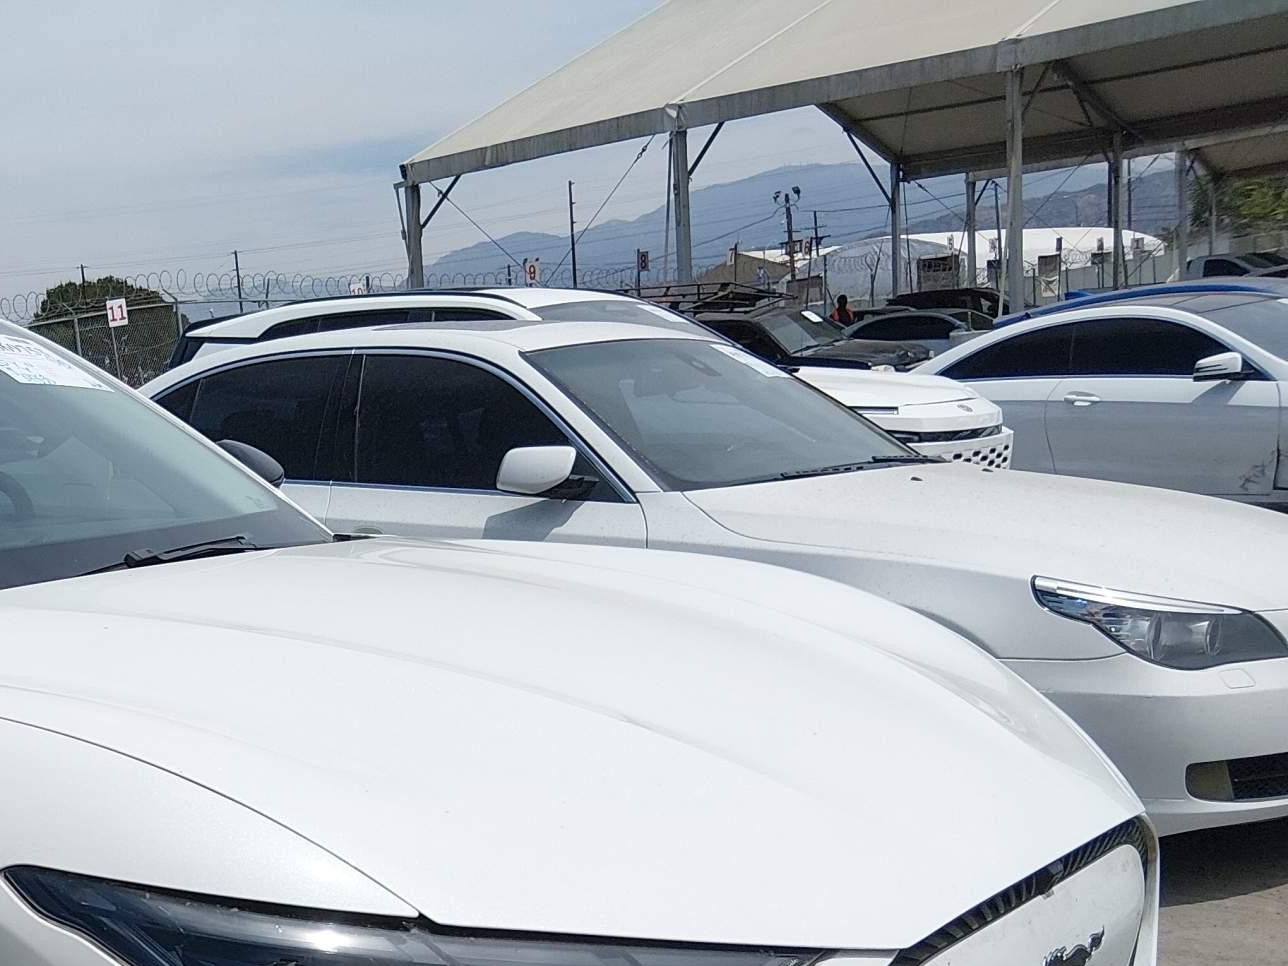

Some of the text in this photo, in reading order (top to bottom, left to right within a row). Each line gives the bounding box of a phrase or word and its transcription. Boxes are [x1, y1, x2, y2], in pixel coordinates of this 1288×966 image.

[640, 254, 648, 270] 8
[529, 264, 537, 281] 9
[108, 303, 127, 322] 11
